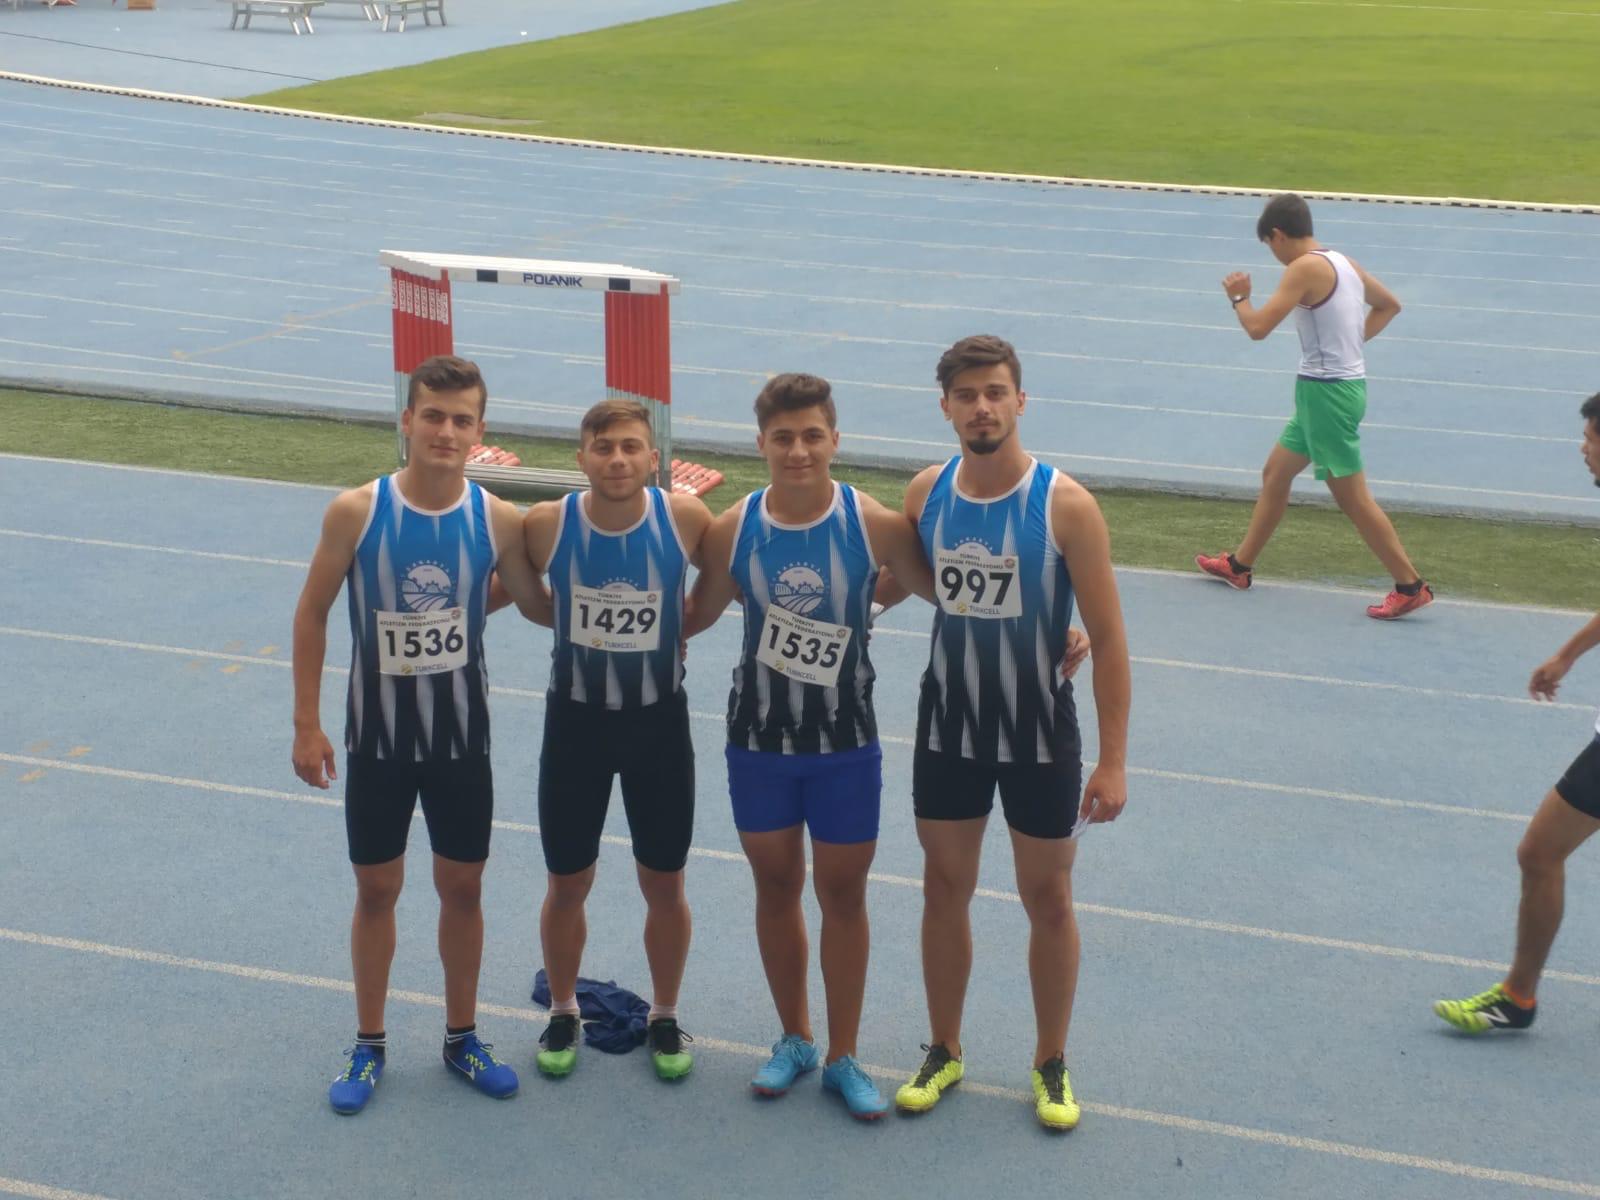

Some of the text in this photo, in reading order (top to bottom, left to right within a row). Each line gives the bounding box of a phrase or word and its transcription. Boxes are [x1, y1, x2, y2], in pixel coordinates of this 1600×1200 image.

[523, 273, 583, 287] POLANIK
[941, 566, 1013, 605] 997
[579, 603, 657, 634] 1429
[385, 625, 463, 658] 1536
[768, 623, 841, 668] 1535
